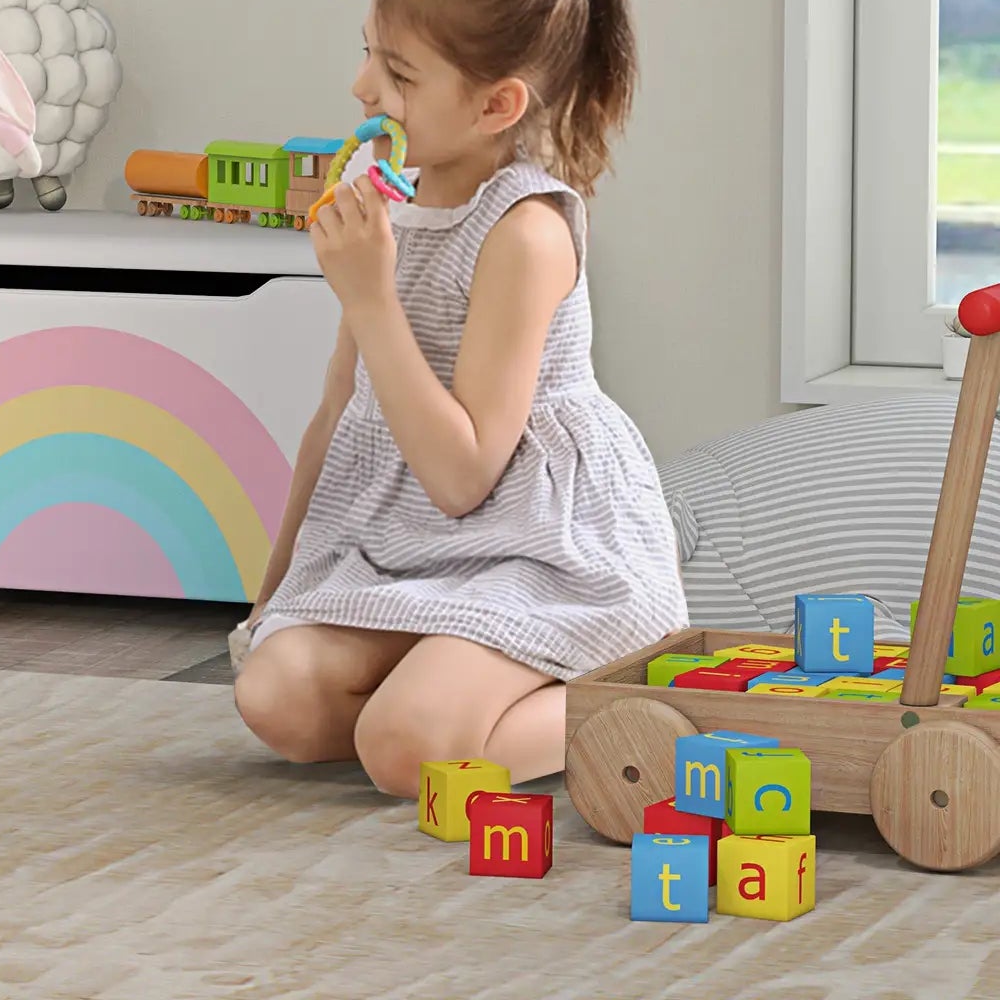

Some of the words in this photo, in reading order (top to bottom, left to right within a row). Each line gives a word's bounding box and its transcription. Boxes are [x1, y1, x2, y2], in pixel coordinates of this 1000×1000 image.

[829, 618, 850, 663] t
[982, 621, 995, 656] a
[426, 776, 439, 826] k
[685, 760, 721, 802] m
[483, 825, 529, 862] m
[658, 863, 681, 911] t
[737, 862, 766, 901] a
[797, 852, 808, 904] f
